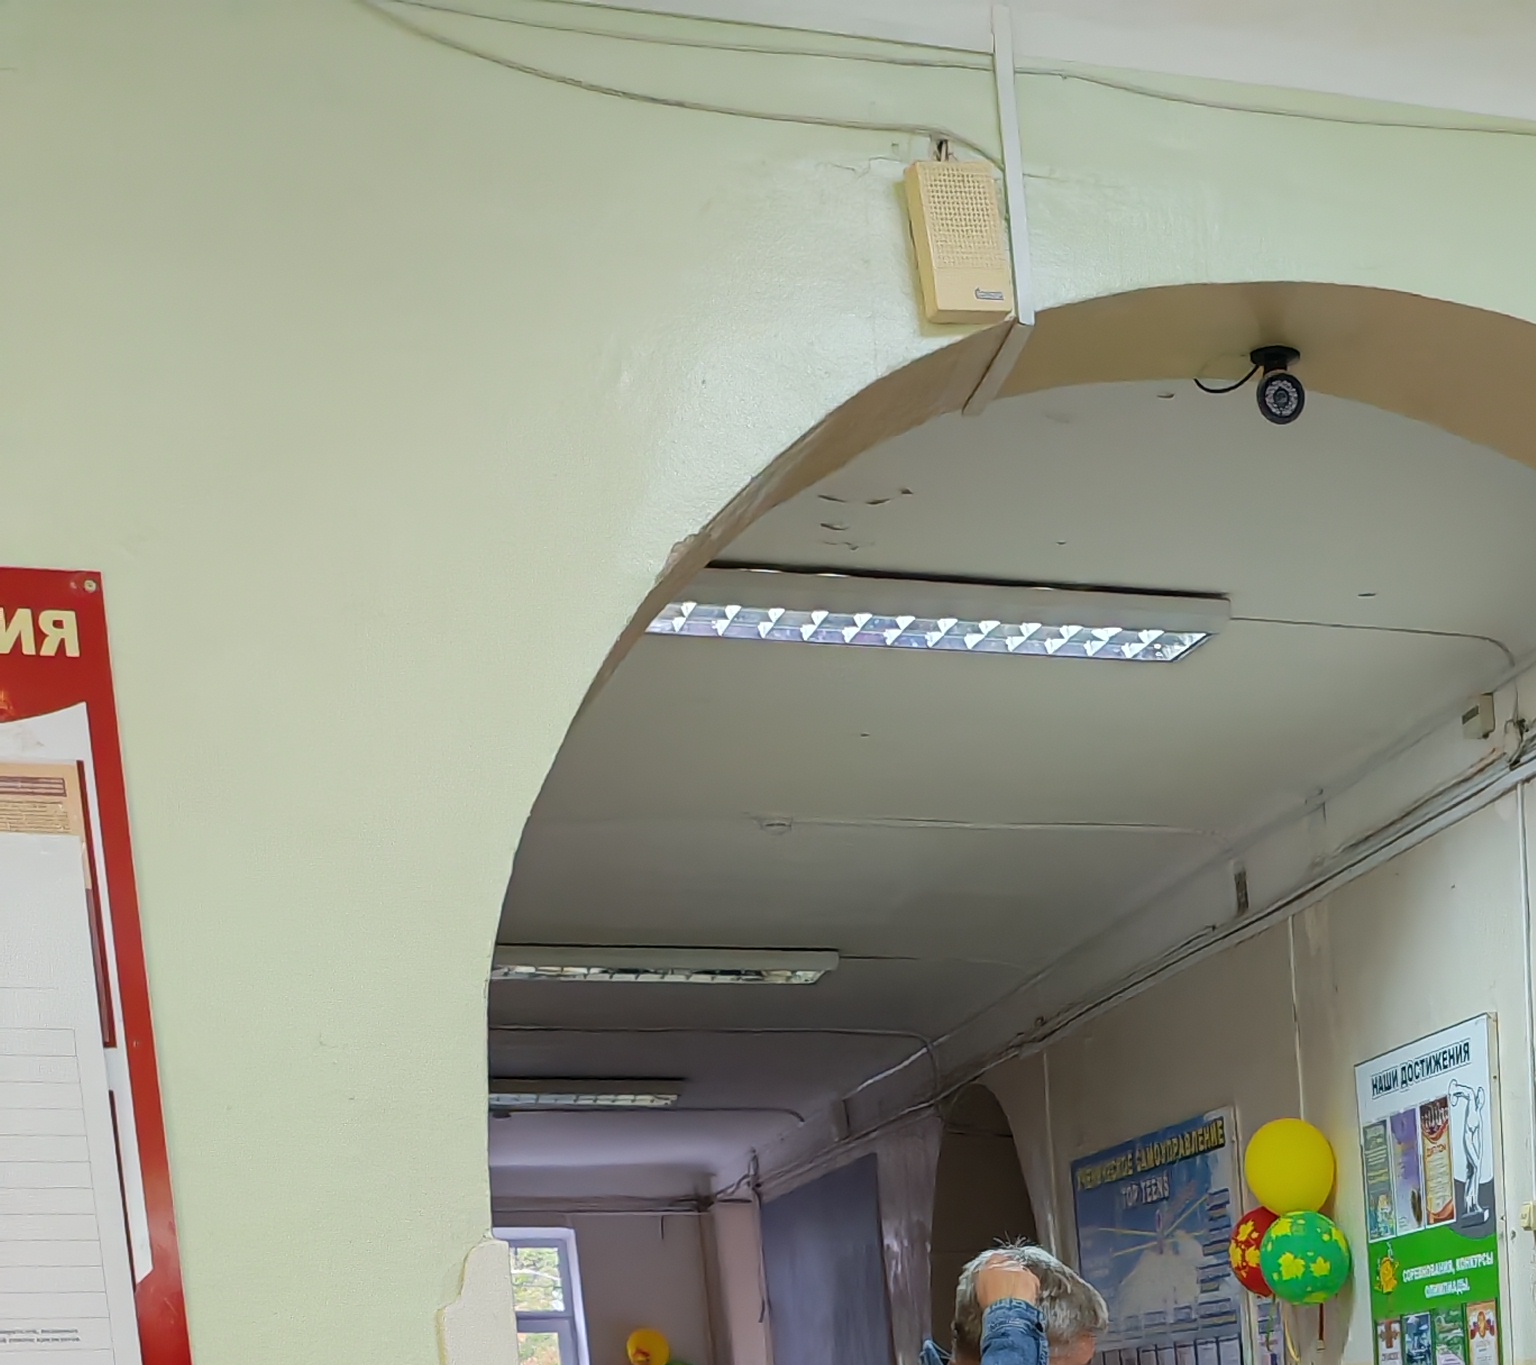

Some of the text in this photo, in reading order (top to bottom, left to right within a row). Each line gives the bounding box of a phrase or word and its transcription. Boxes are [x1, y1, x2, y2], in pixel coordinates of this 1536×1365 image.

[1371, 1041, 1471, 1096] НАШИ ДОСТИЖЕНИЯ
[1136, 1116, 1226, 1173] САМОУПРАВЛЕНИЕ
[1121, 1173, 1170, 1209] TOP TEENS
